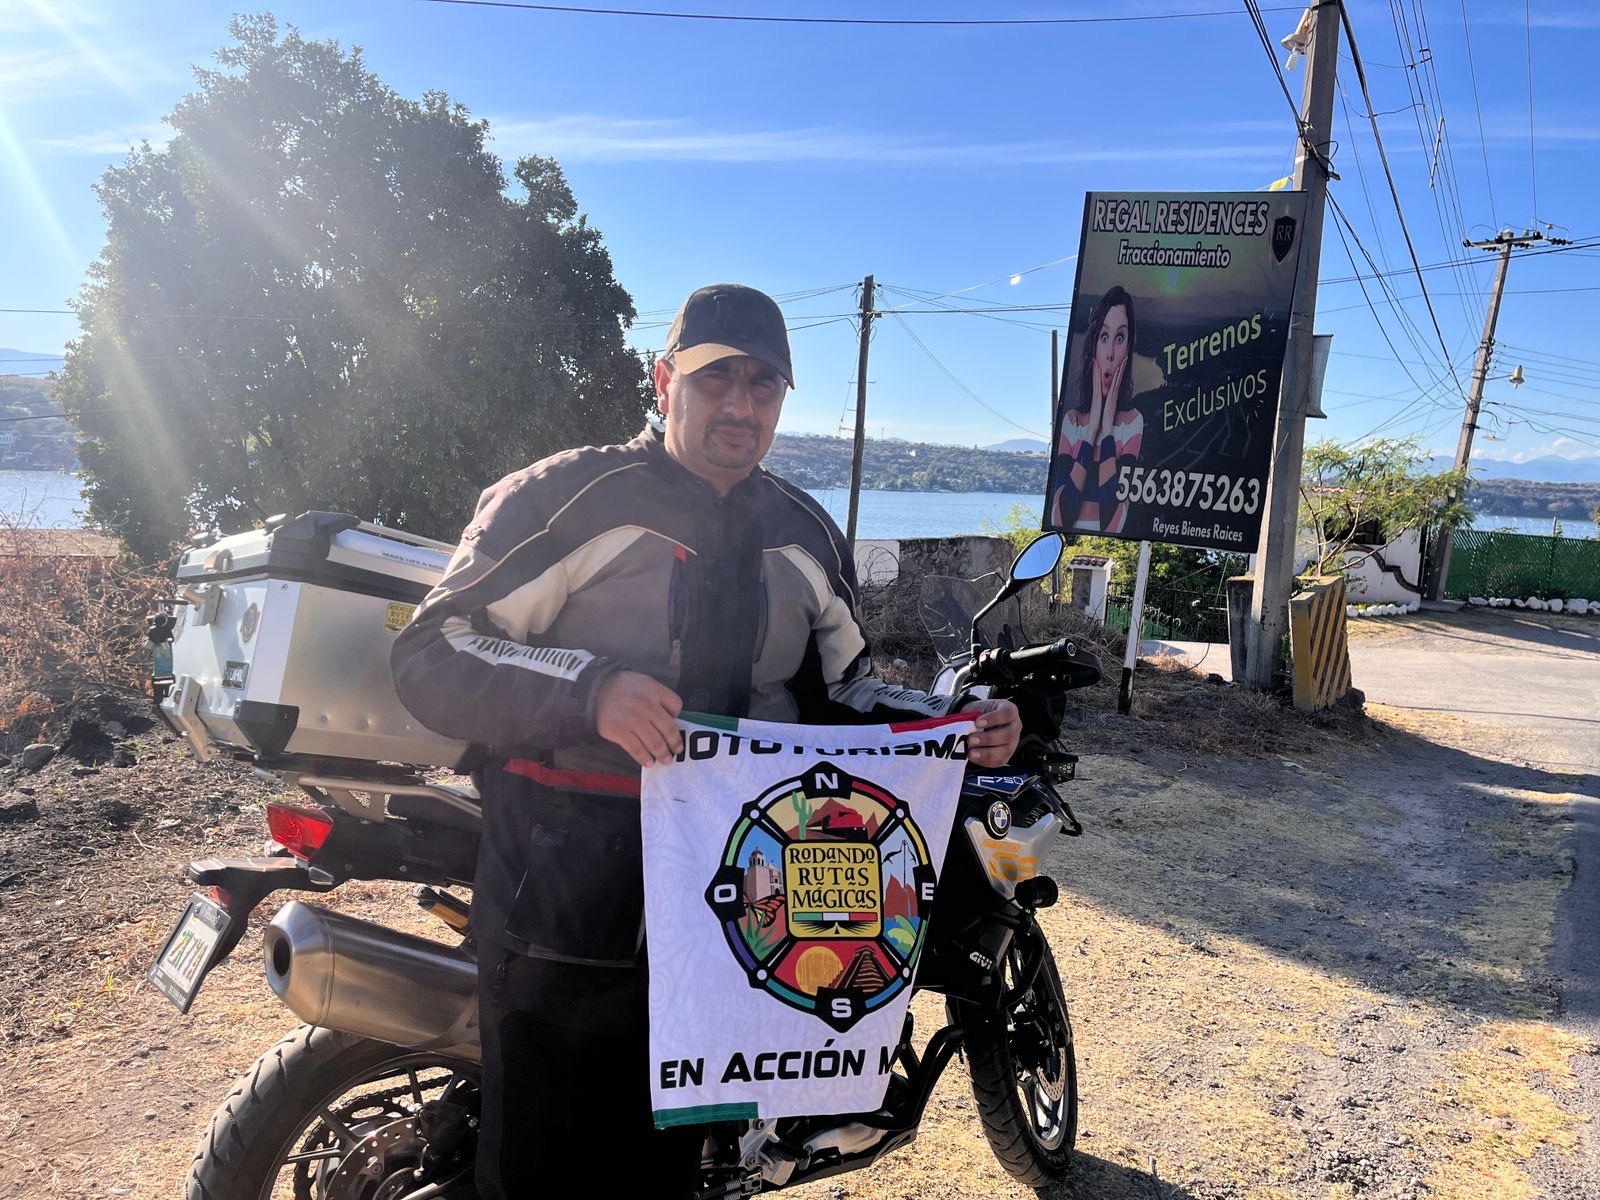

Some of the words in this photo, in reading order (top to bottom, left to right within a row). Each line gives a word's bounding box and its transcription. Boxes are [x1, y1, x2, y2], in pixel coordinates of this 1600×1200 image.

[1093, 199, 1151, 232] REGAL
[1154, 201, 1269, 235] RESIDENCES
[1118, 239, 1231, 268] Fraccionamiento
[1163, 312, 1262, 375] Terrenos
[1163, 368, 1267, 432] Exclusivos
[1116, 465, 1260, 515] 5563875263
[1152, 517, 1180, 538] Reyes
[1181, 520, 1211, 539] Bienes
[815, 772, 839, 790] N
[713, 883, 737, 903] O
[921, 882, 936, 901] E
[969, 951, 993, 971] GIVI
[831, 997, 852, 1019] S
[660, 1057, 705, 1090] EN
[720, 1038, 866, 1084] ACCIÓN
